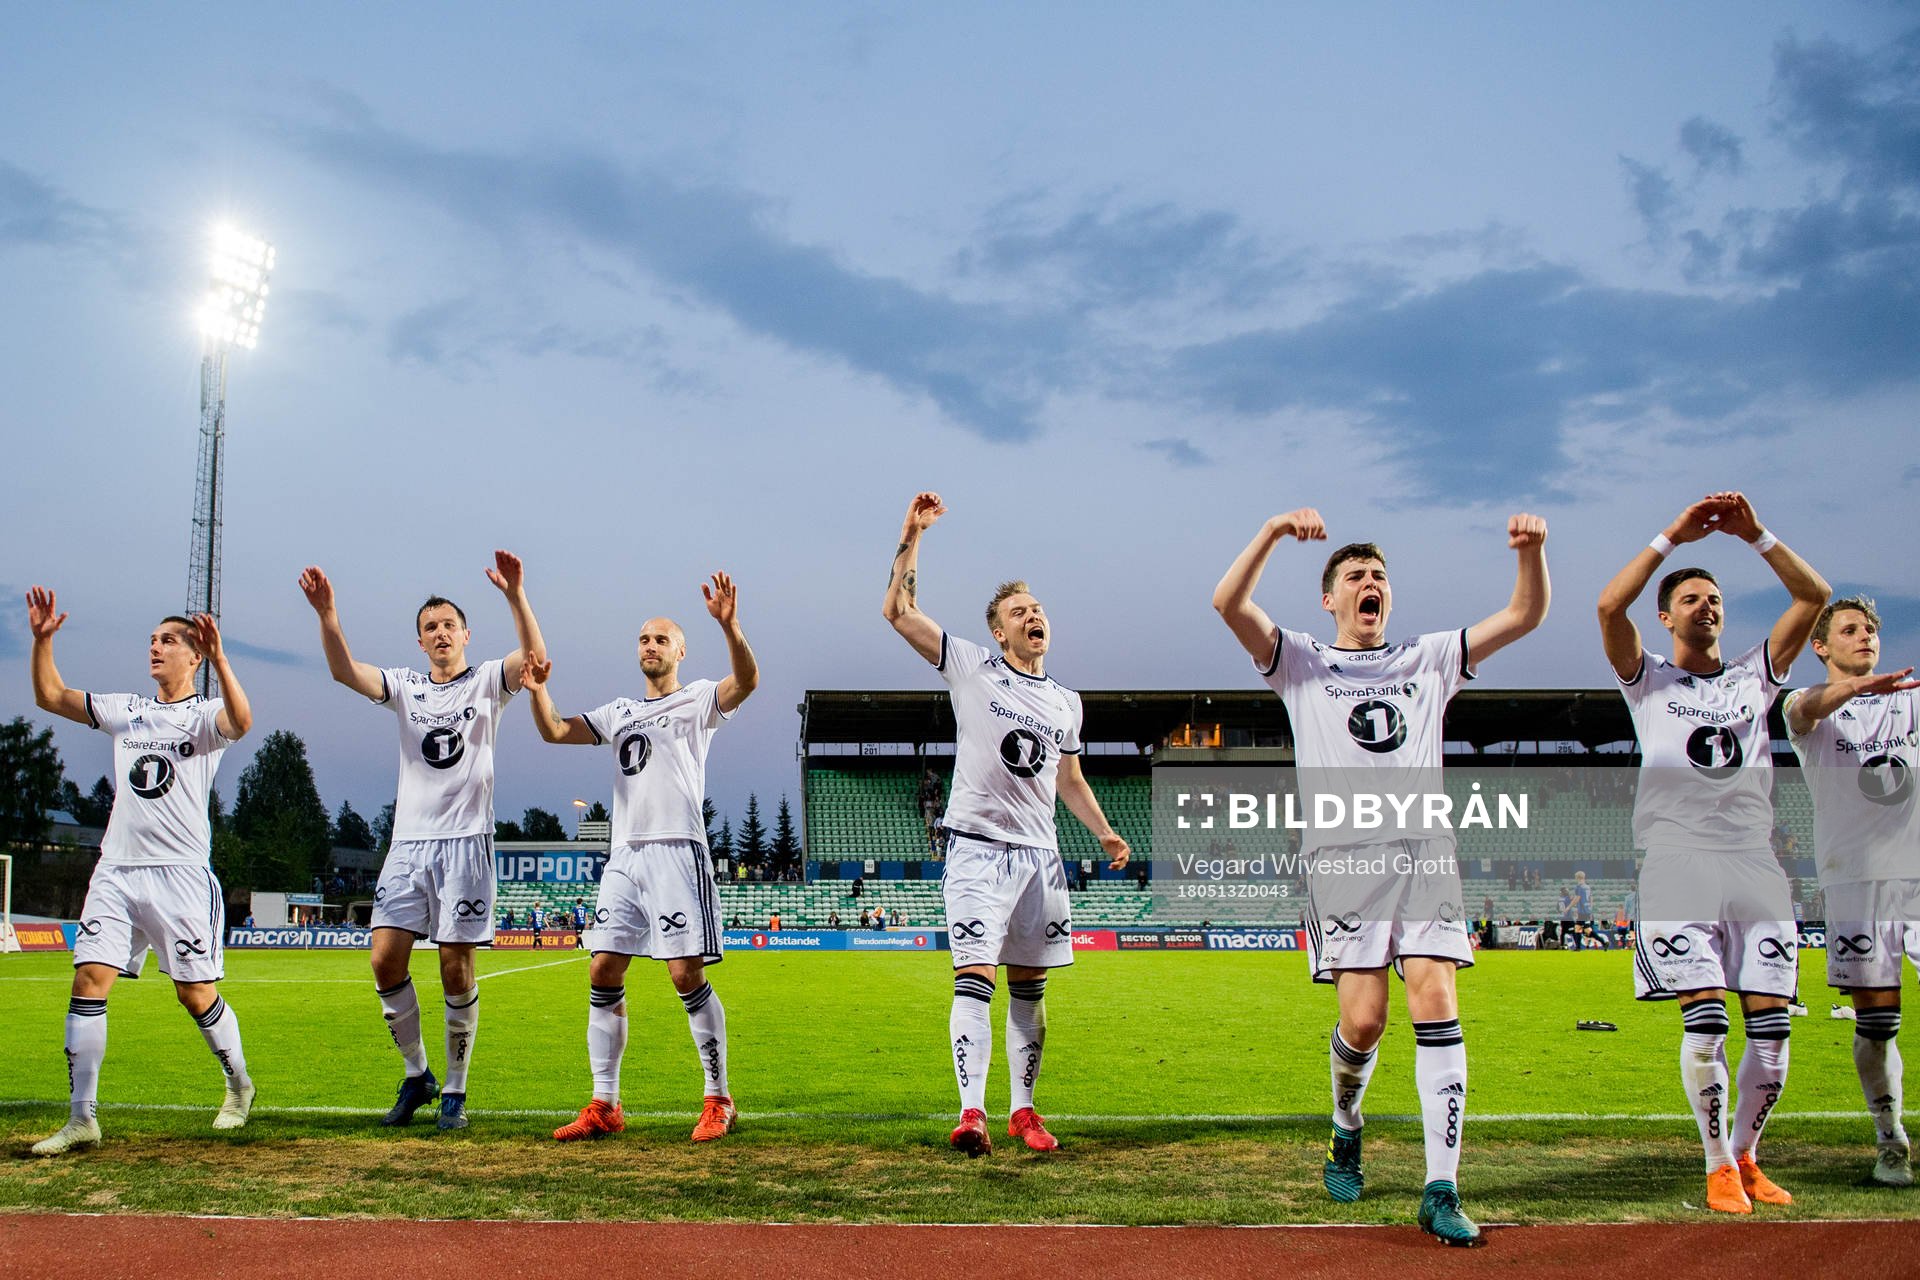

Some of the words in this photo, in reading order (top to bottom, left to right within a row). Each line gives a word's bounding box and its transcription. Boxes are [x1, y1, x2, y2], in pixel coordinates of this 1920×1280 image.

[1325, 684, 1402, 699] SpareBank
[989, 702, 1054, 738] SpareBank
[123, 738, 178, 753] SpareBank
[1836, 736, 1907, 753] SpareBank
[230, 930, 313, 945] macron
[723, 936, 750, 945] Bank
[769, 936, 820, 946] Østlandet
[1208, 933, 1296, 949] macron
[1445, 1097, 1460, 1148] coop
